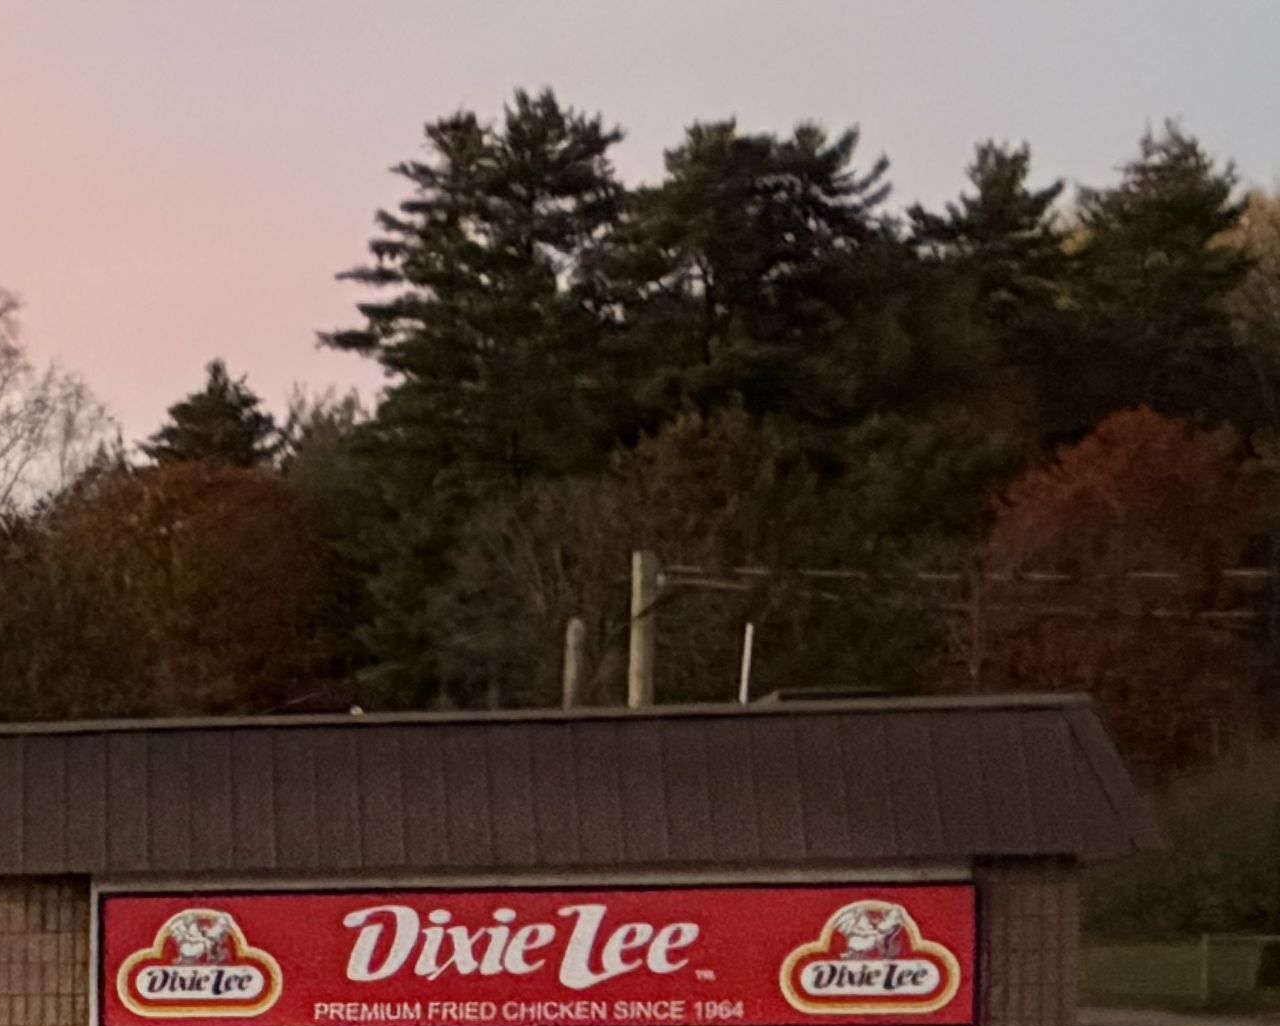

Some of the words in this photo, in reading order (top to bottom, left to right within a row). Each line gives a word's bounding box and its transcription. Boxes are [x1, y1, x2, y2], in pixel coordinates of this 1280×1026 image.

[342, 904, 556, 982] Dixie
[557, 904, 700, 990] Lee
[146, 969, 210, 993] Dixie
[211, 968, 253, 995] Lee
[812, 964, 882, 989] Dixie
[883, 963, 928, 990] Lee
[314, 1002, 421, 1021] PREMIUM
[428, 1001, 497, 1020] FRIED
[502, 1001, 607, 1020] CHICKEN
[614, 1001, 685, 1020] SINCE
[694, 1000, 745, 1019] 1964
